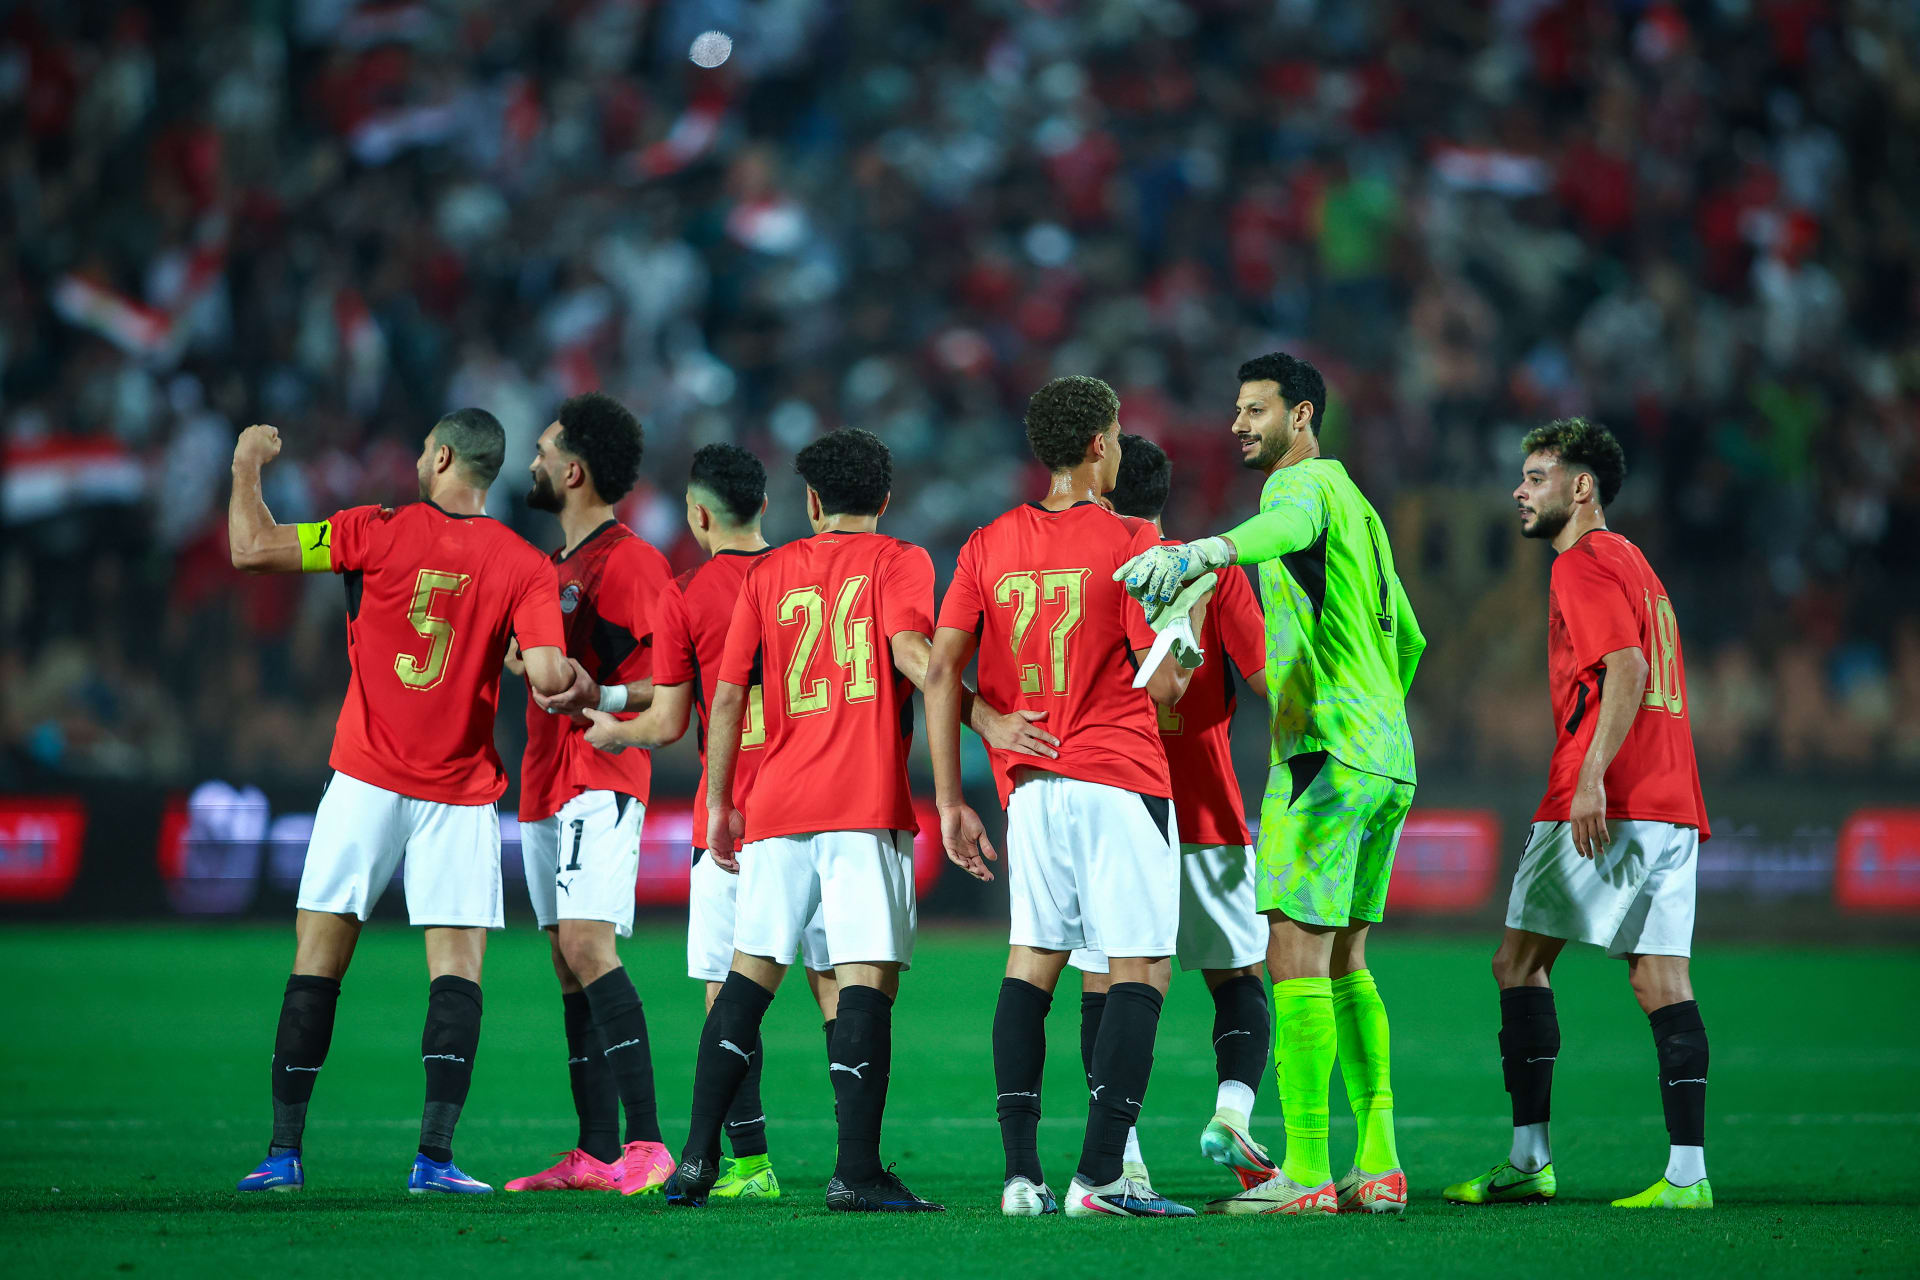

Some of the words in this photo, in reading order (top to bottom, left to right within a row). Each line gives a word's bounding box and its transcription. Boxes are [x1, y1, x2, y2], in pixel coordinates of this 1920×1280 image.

[393, 569, 471, 691] 5
[776, 574, 877, 718] 24
[993, 568, 1093, 697] 27
[1641, 587, 1684, 718] 18
